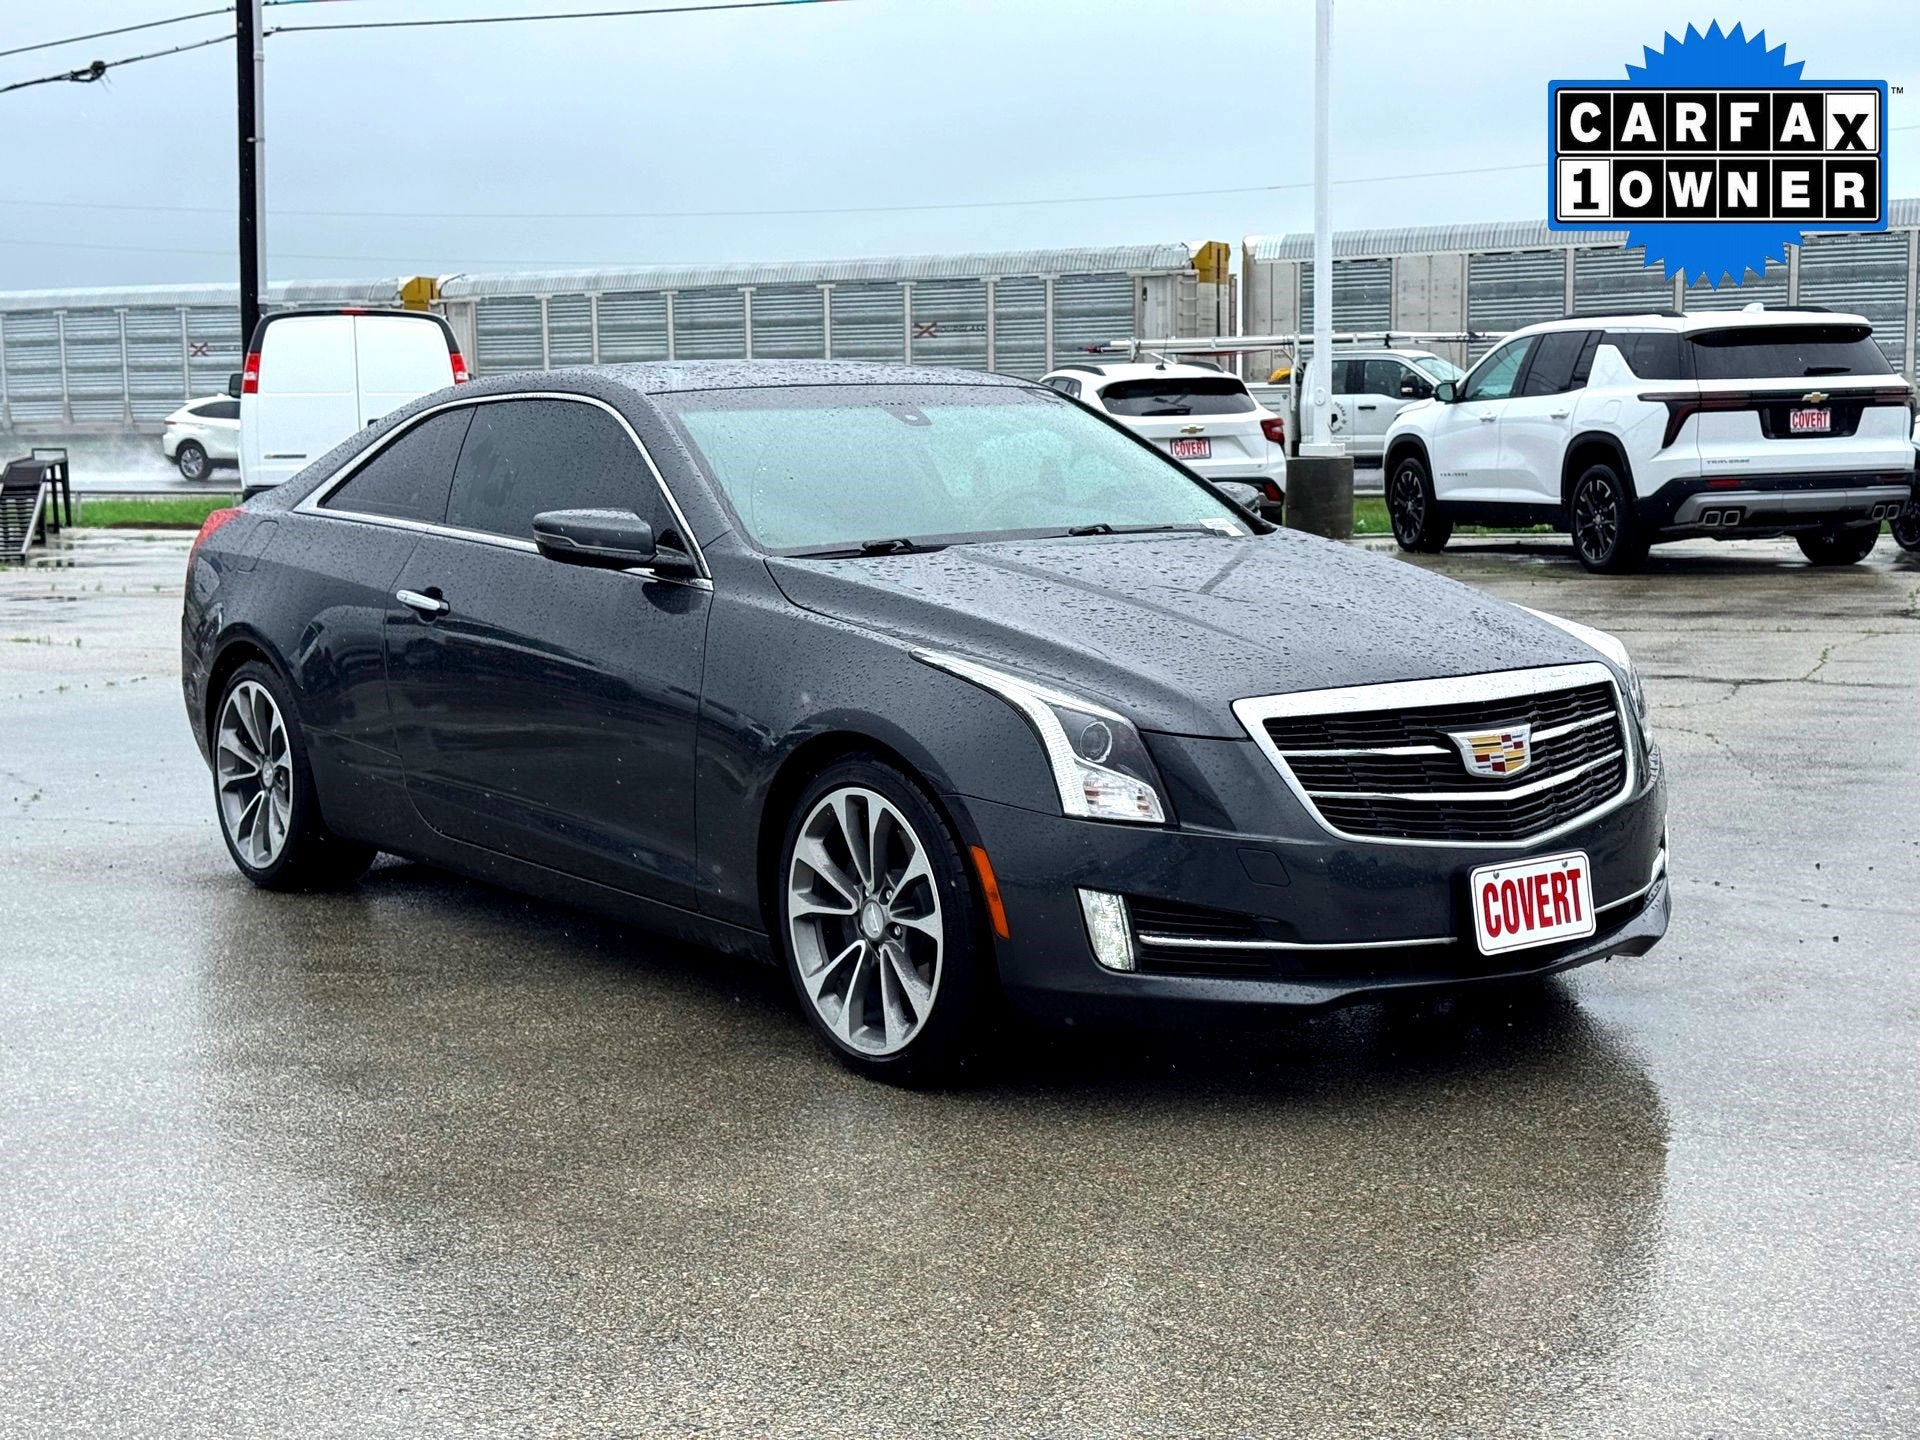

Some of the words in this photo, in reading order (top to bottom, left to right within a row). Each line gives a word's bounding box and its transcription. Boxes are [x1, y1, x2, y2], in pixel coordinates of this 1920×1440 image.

[1792, 412, 1827, 427] COVERT
[1174, 441, 1206, 455] COVERT
[1482, 868, 1582, 938] COVERT
